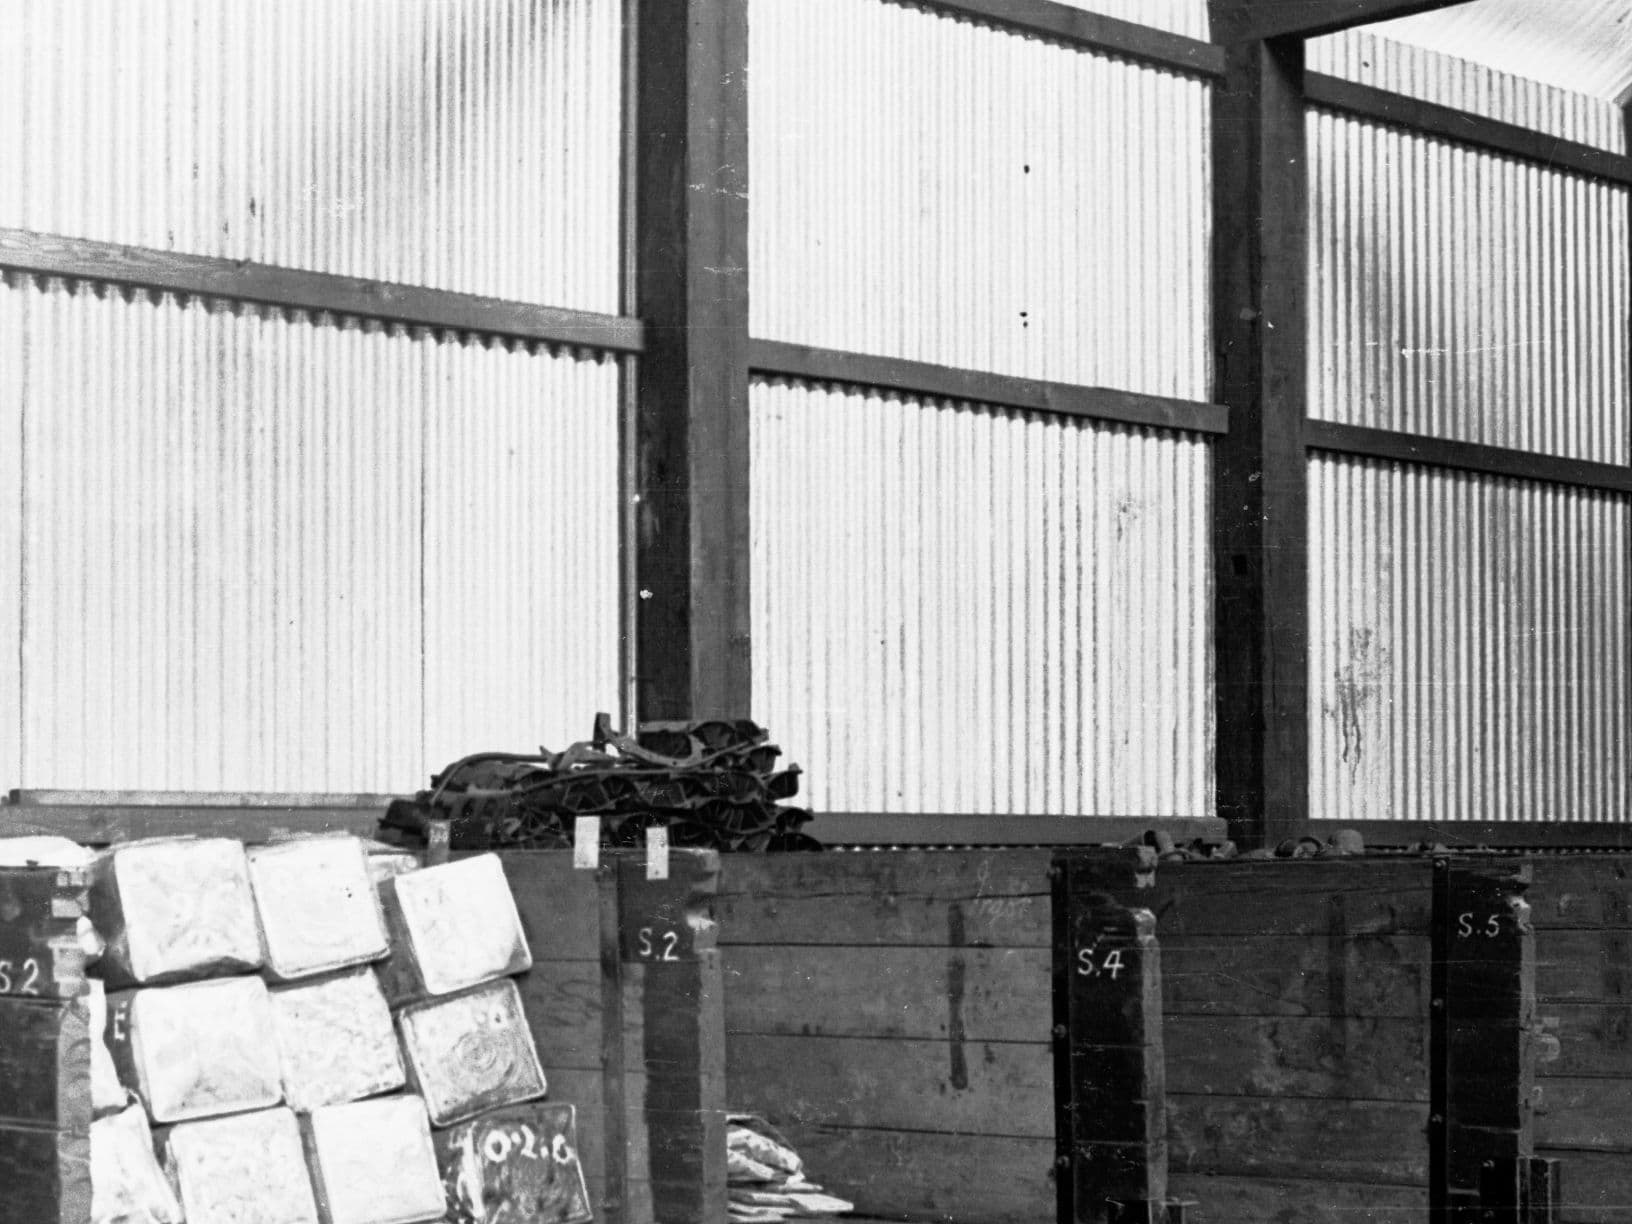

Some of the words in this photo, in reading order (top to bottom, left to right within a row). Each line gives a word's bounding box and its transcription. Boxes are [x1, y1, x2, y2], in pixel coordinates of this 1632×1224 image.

[1458, 912, 1500, 938] S.5
[639, 927, 679, 961] S.2
[1078, 948, 1125, 979] S.4
